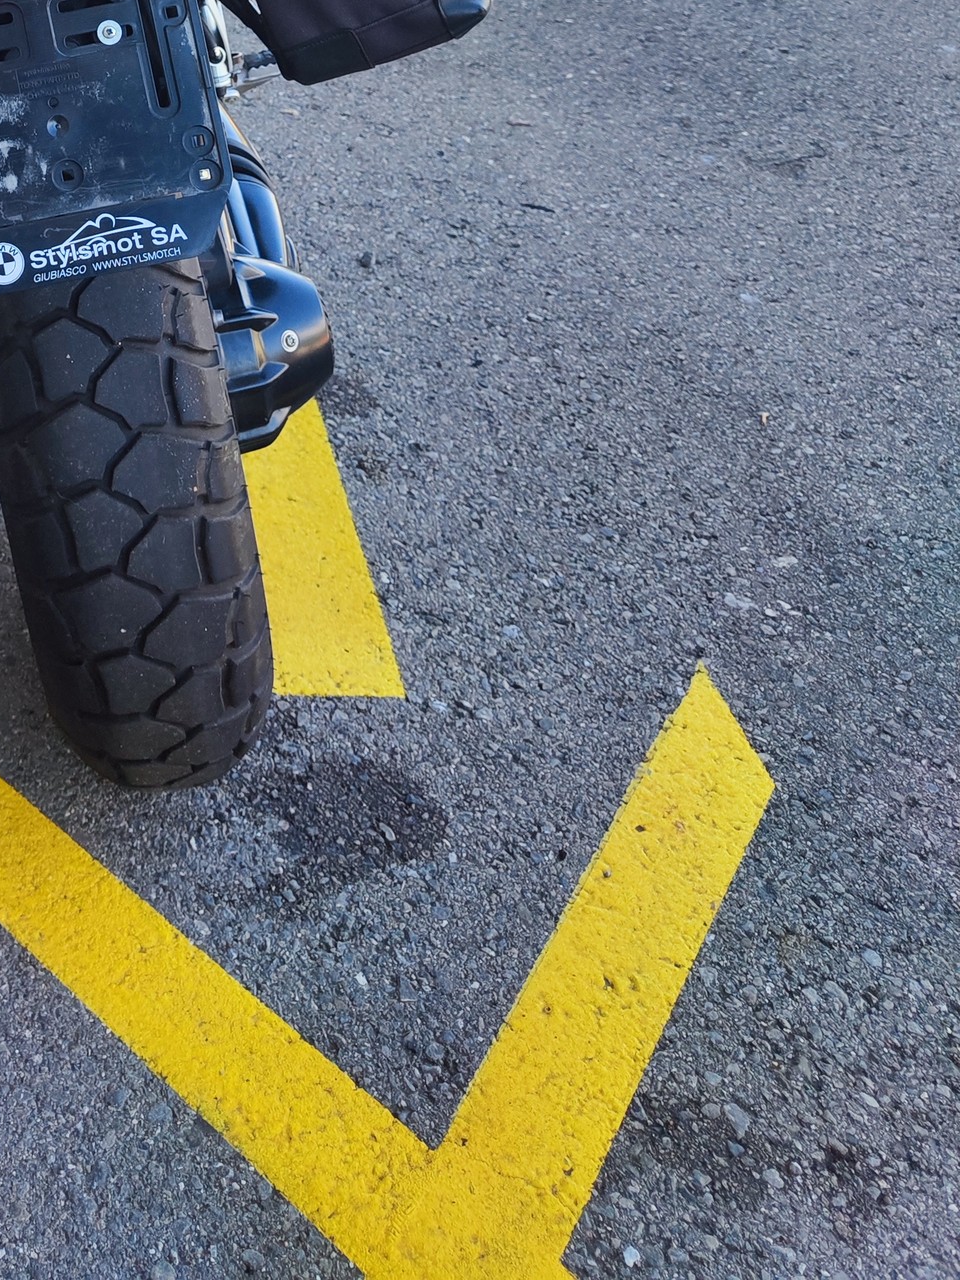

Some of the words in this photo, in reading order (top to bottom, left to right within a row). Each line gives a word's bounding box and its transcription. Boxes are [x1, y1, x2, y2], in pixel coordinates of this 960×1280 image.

[29, 231, 143, 269] Stylsmot
[150, 223, 189, 246] SA
[33, 264, 87, 284] GIUBIASCO
[92, 246, 182, 272] WWW.STYLSMOT.CH
